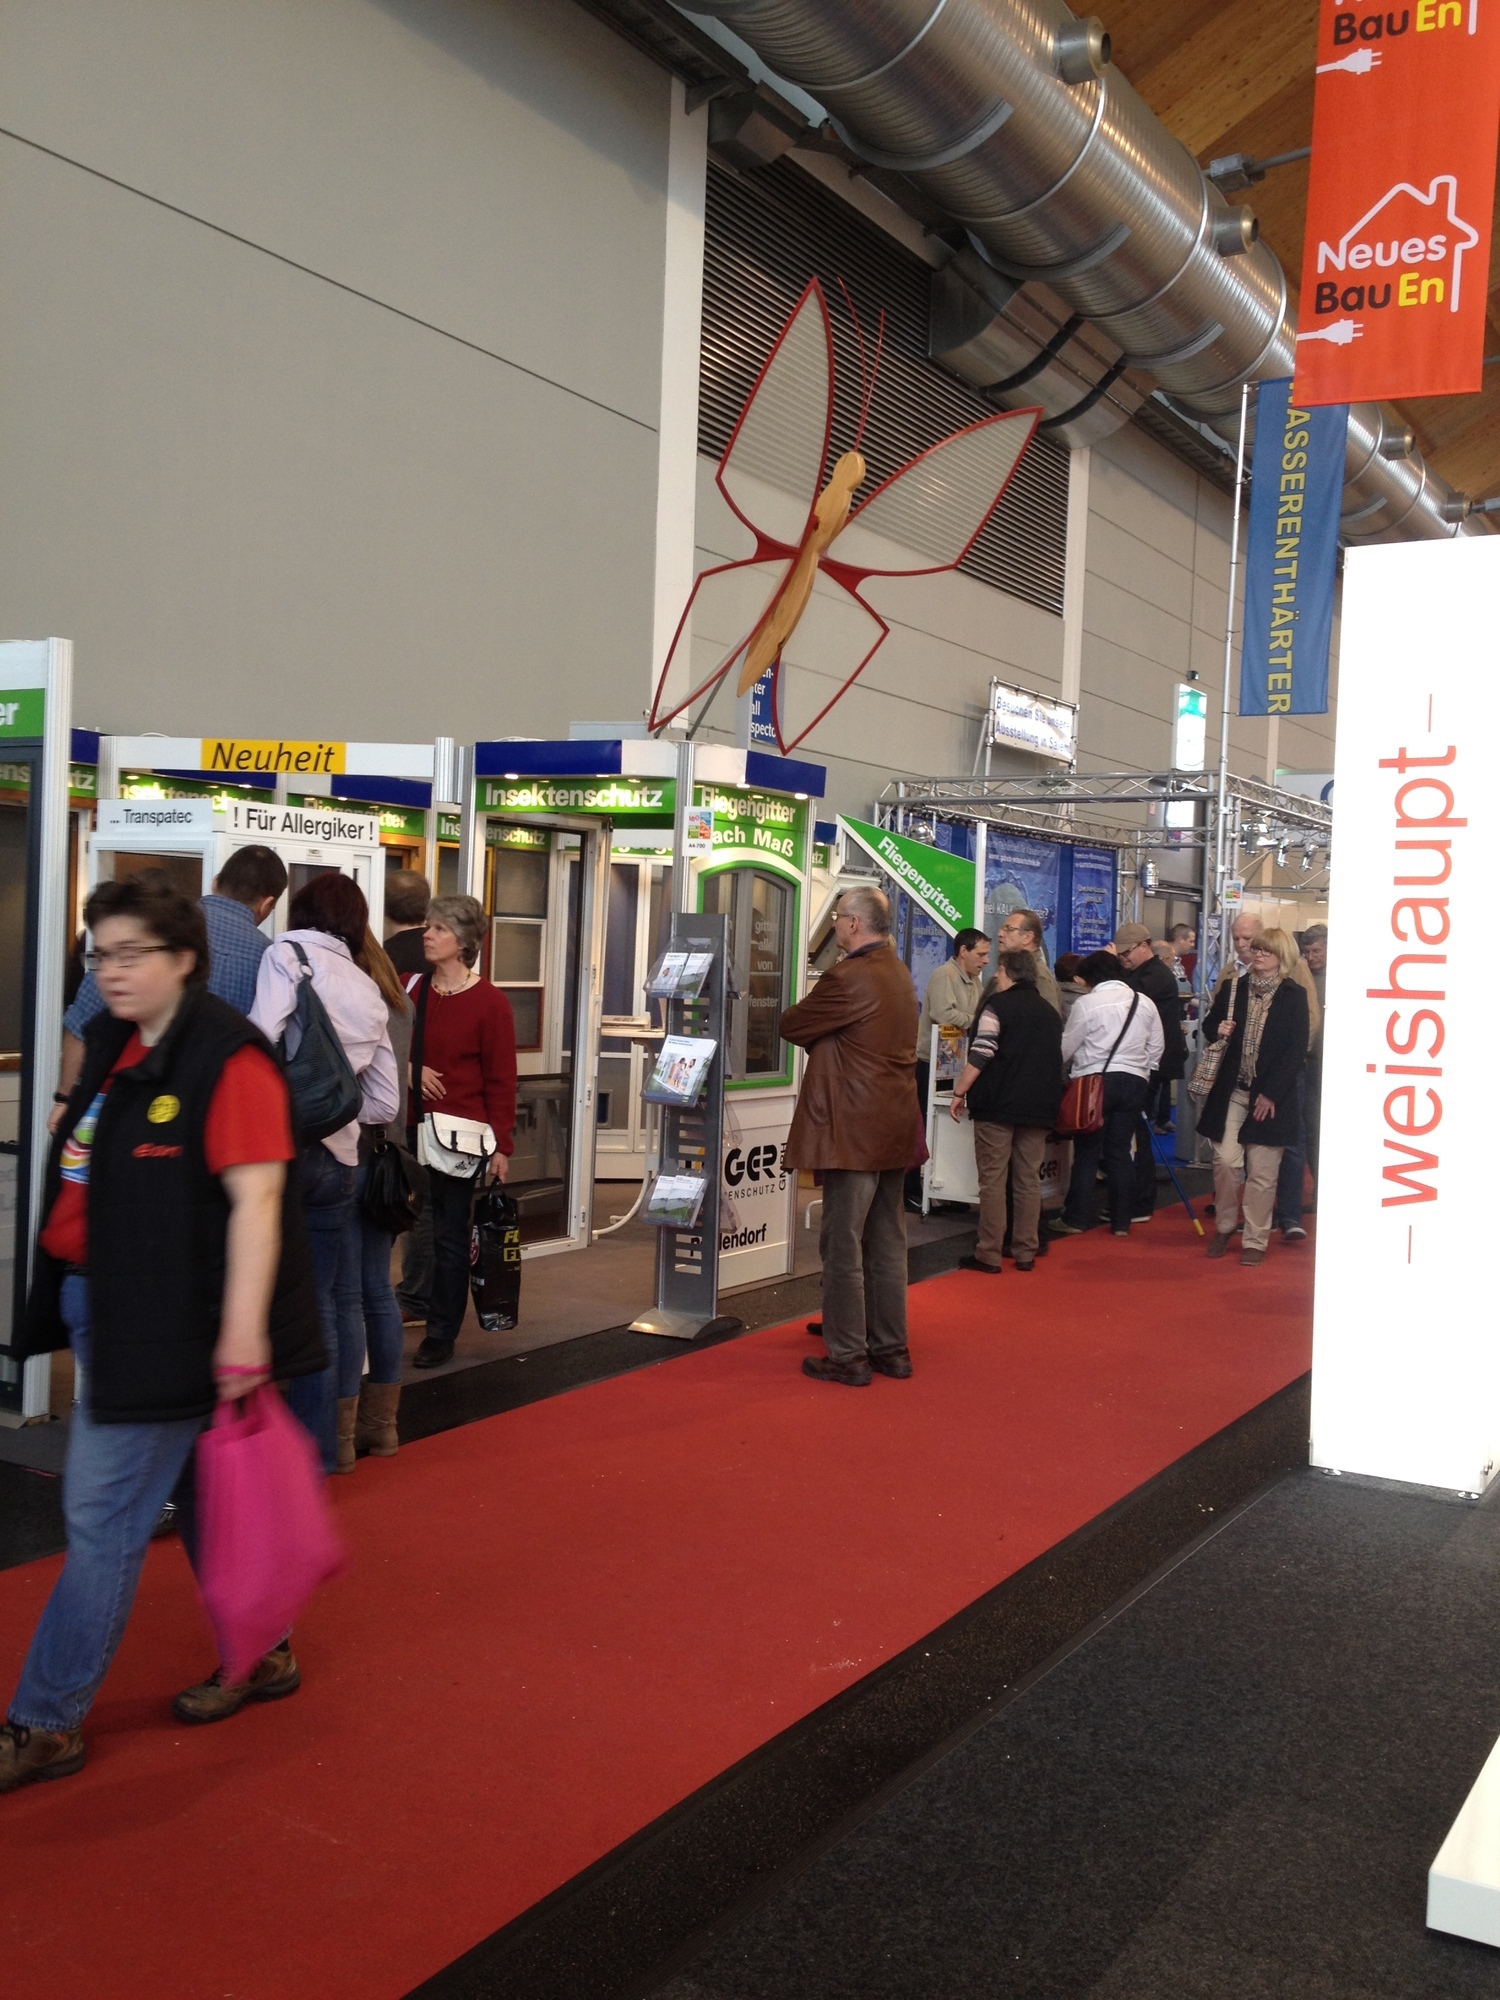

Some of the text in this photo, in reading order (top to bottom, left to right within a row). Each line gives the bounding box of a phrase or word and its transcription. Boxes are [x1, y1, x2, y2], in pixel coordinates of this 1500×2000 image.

[1316, 234, 1447, 274] Neues
[1266, 382, 1311, 715] ASSERENTHÄRTER
[996, 696, 1033, 720] Besuchen
[1034, 708, 1046, 724] Sie
[995, 720, 1040, 748] Ausstellung
[210, 742, 335, 773] Neuheit
[485, 783, 663, 808] Insektenschutz
[701, 787, 796, 825] Fliegengitter
[123, 808, 193, 827] Transpatec
[246, 807, 277, 832] Für
[280, 811, 365, 841] Allergiker
[440, 817, 546, 846] Insenschutz
[711, 825, 794, 858] ach Maß
[877, 835, 963, 922] Fliegengitter
[757, 960, 773, 971] von
[1365, 745, 1468, 1208] weishaupt
[724, 1183, 775, 1201] ENSCHUTZ
